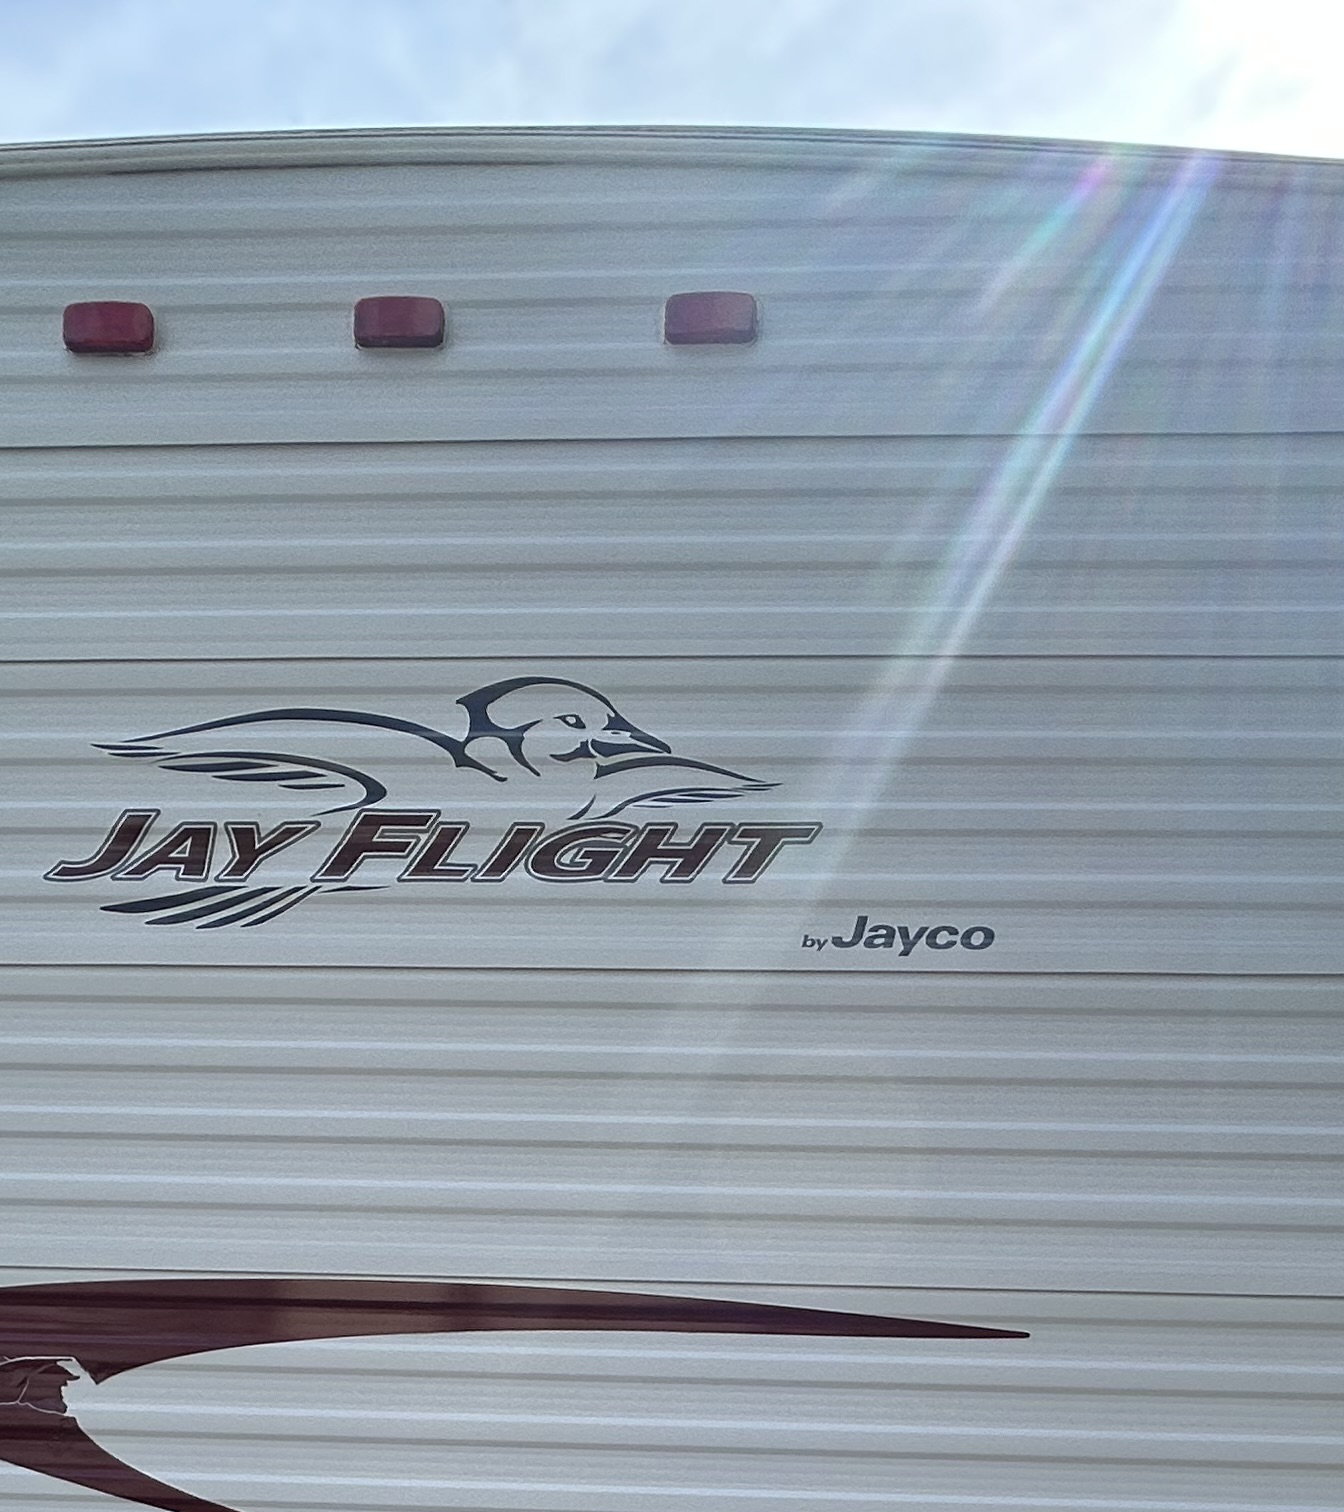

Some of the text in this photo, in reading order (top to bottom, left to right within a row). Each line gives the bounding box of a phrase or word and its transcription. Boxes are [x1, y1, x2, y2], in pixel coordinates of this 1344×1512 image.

[43, 808, 823, 884] JAY FLIGHT
[801, 915, 995, 957] by Jayco
